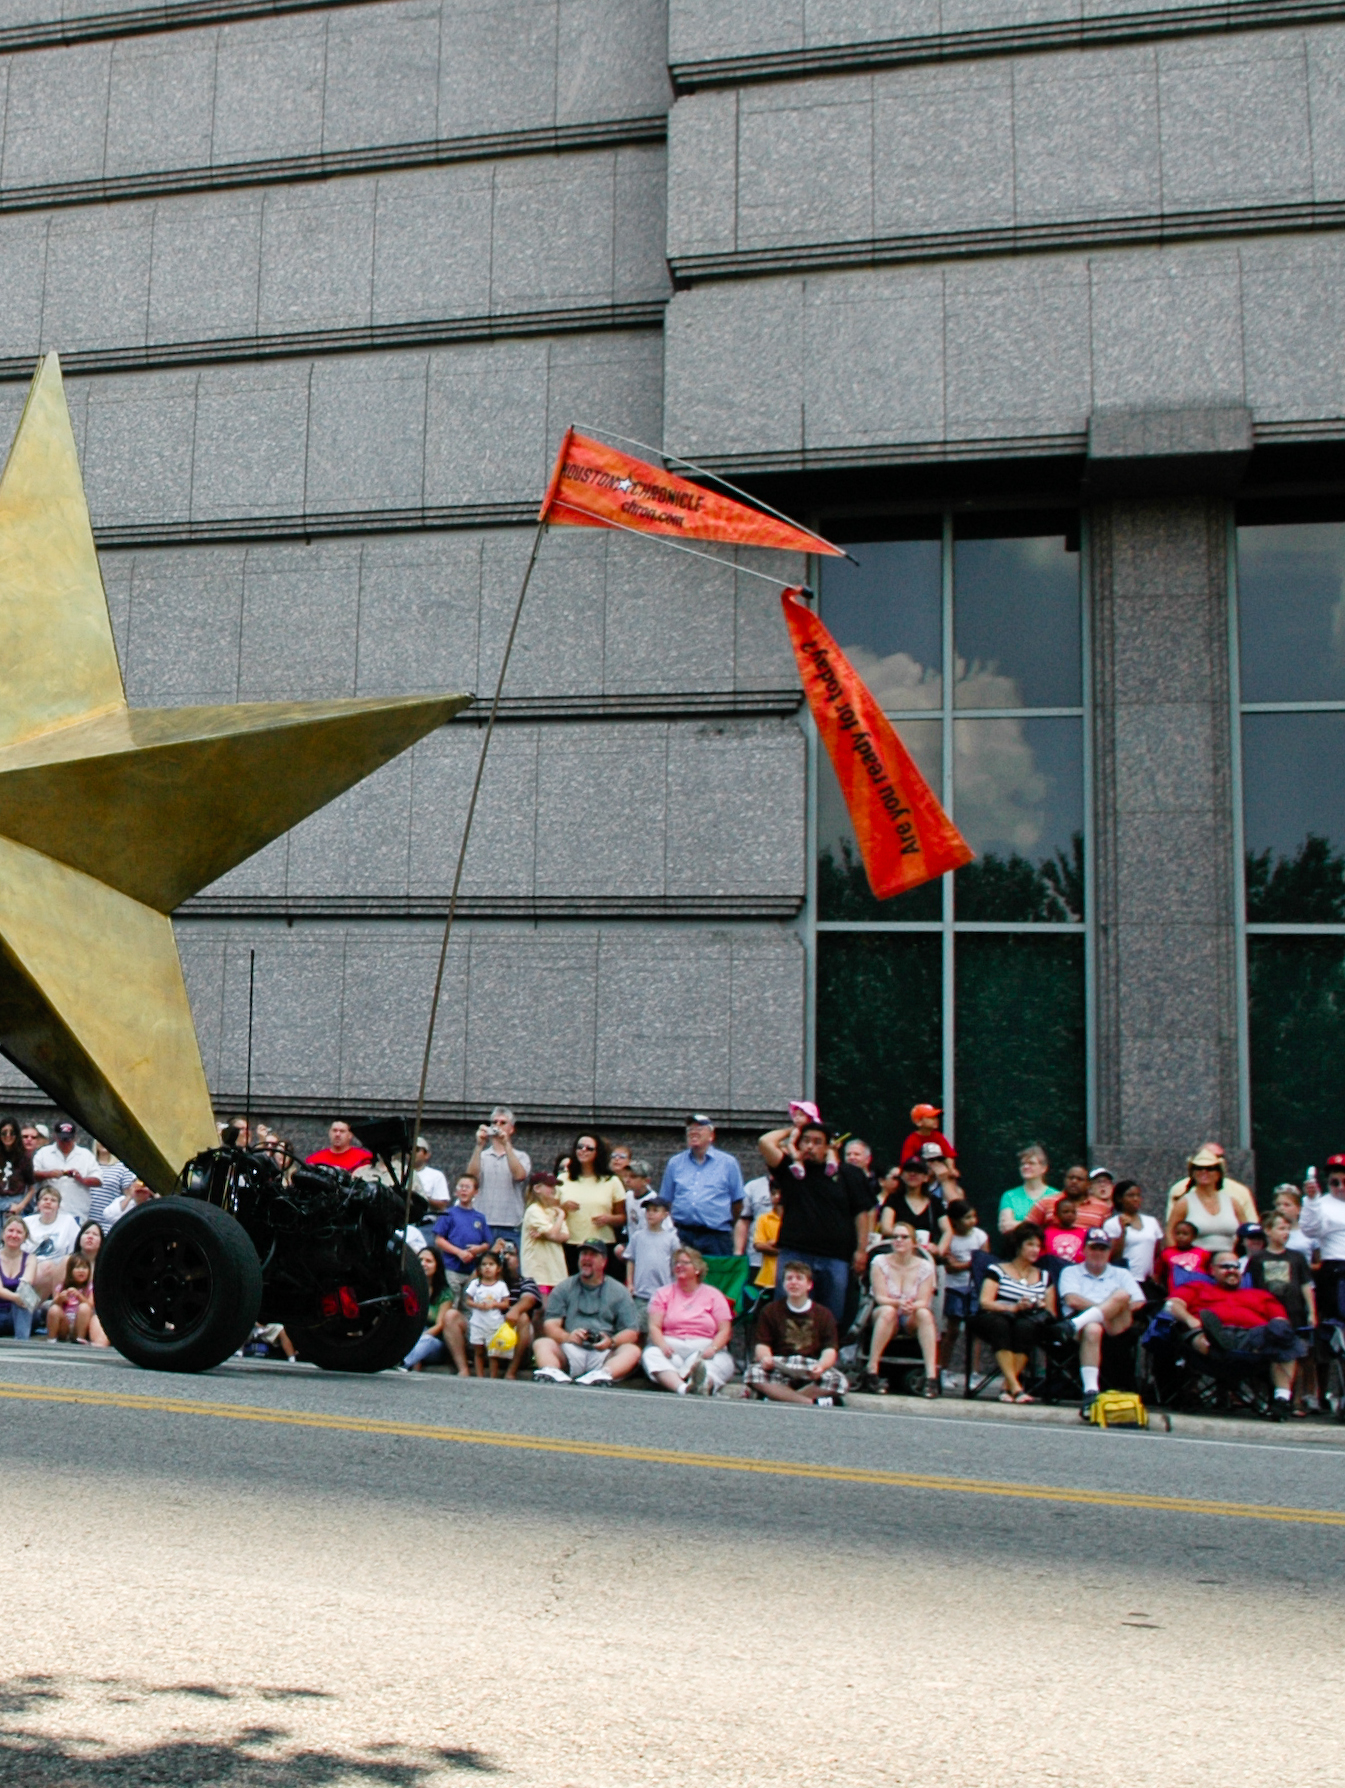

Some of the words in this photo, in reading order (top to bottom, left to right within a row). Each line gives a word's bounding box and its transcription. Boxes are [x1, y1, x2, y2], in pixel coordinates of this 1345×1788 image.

[561, 462, 618, 491] HOUSTON
[630, 481, 705, 512] CHRONICLE
[621, 500, 684, 528] chron.com
[801, 641, 843, 701] today?
[834, 703, 859, 730] for
[851, 732, 888, 784] ready
[878, 785, 911, 821] you
[896, 822, 920, 854] Are
